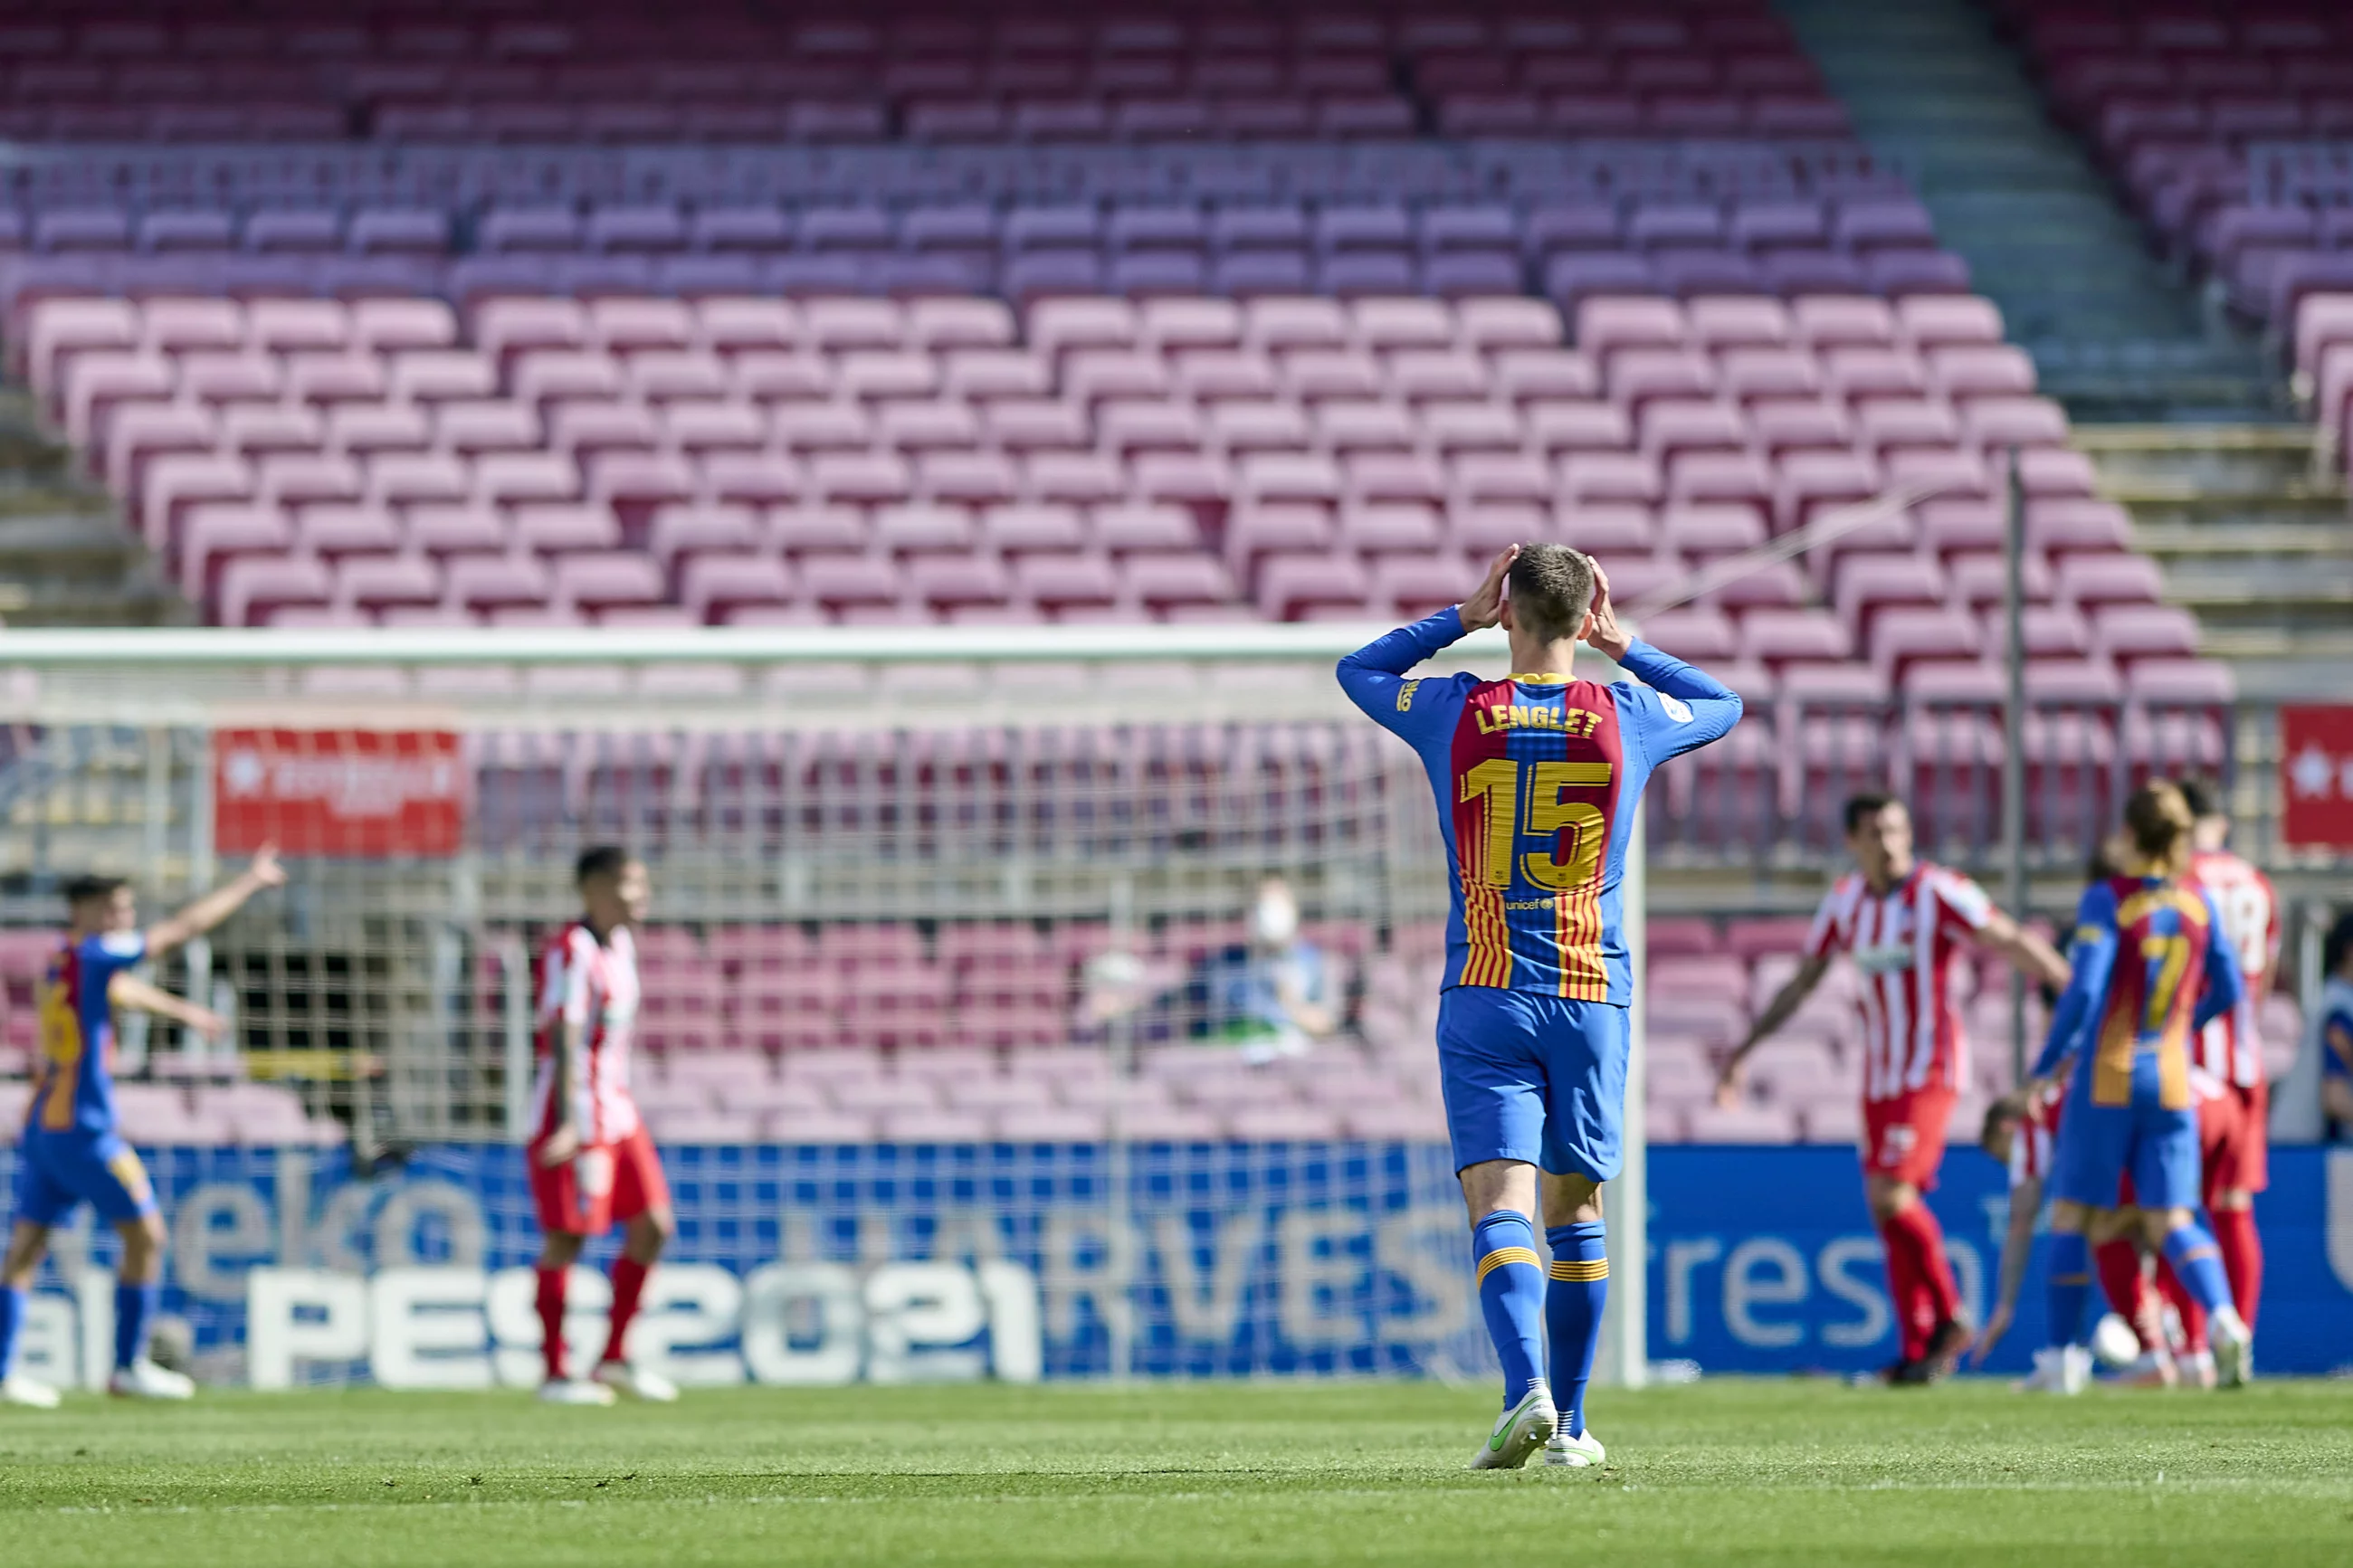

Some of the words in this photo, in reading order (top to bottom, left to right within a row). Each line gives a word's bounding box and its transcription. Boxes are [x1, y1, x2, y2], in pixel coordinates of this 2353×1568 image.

[1396, 679, 1421, 712] eko
[1474, 704, 1604, 737] LENGLET
[1459, 758, 1613, 893] 15
[1505, 898, 1540, 910] unicef
[2139, 936, 2189, 1030] 7
[249, 1263, 614, 1391] PES
[623, 1261, 1041, 1388] 2021
